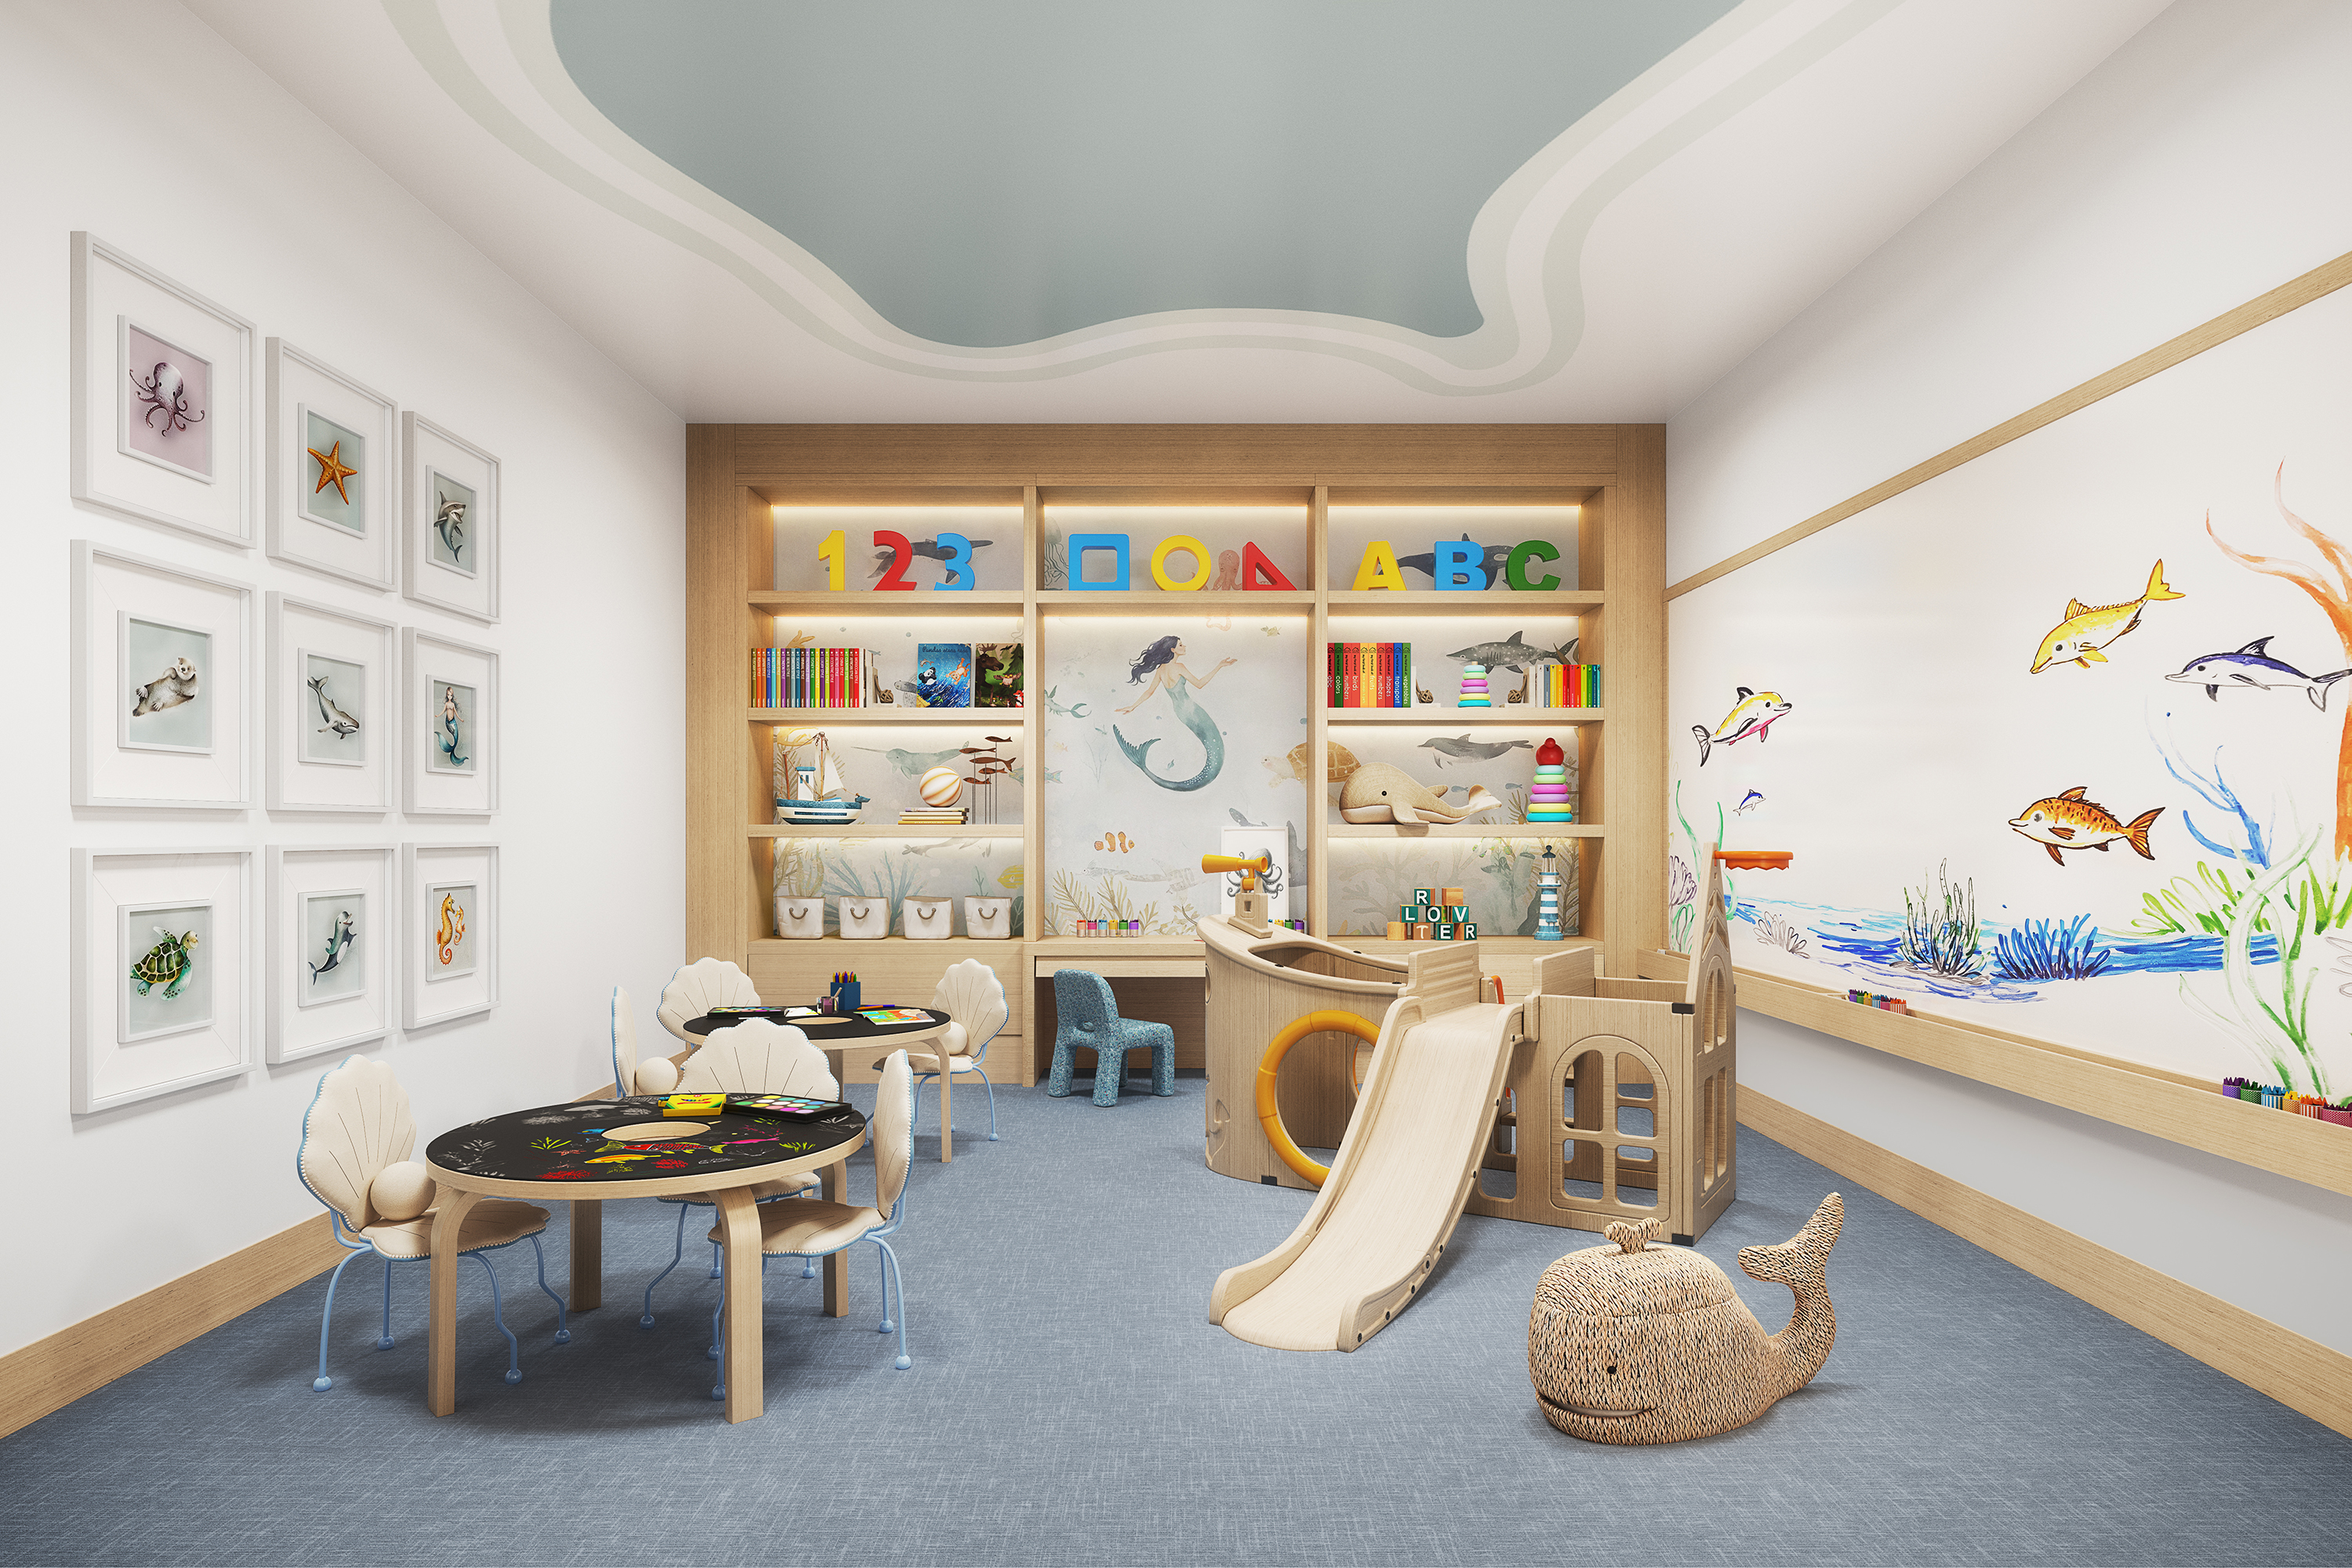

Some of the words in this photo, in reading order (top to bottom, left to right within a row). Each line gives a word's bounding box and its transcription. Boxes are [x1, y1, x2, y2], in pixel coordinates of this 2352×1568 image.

[818, 530, 845, 590] 1
[873, 530, 917, 590] 2
[933, 532, 975, 590] 3
[1352, 540, 1407, 590] A
[1434, 541, 1487, 590] B
[1505, 540, 1561, 590] C
